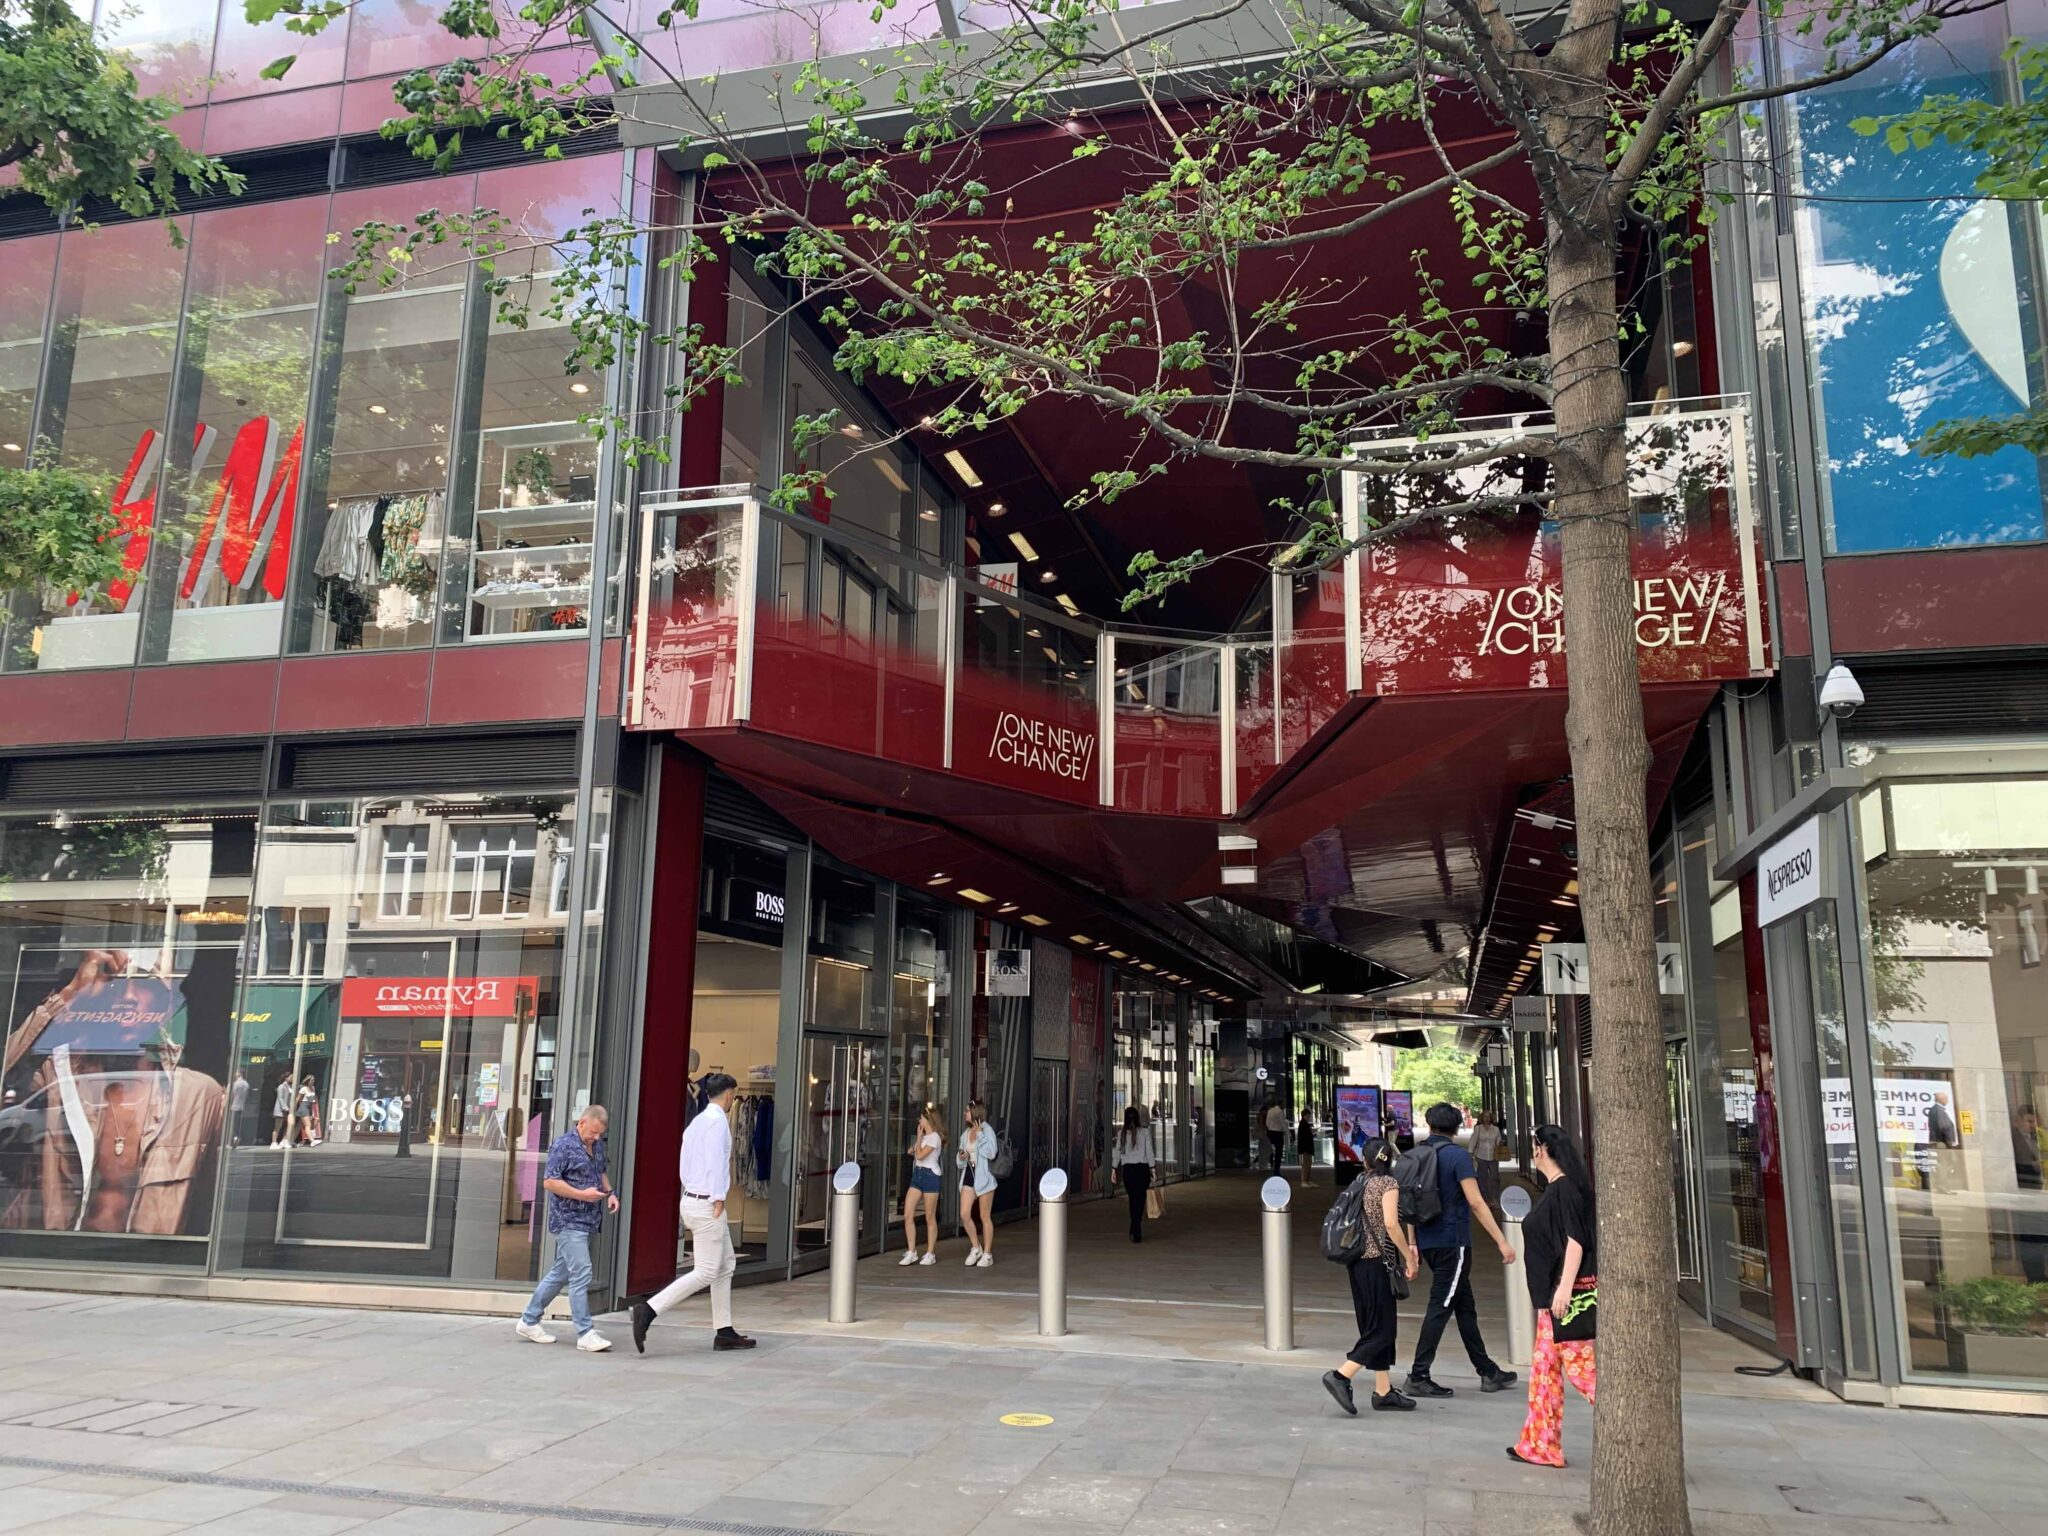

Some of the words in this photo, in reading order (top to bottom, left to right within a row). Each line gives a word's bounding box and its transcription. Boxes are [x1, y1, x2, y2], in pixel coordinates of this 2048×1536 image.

[1495, 612, 1694, 655] CHGE
[1003, 713, 1044, 746] ONE
[1048, 725, 1089, 757] NEW
[997, 737, 1081, 780] CHANGE
[756, 891, 784, 916] BOSS
[991, 965, 1027, 977] BOSS
[329, 1098, 404, 1123] BOSS
